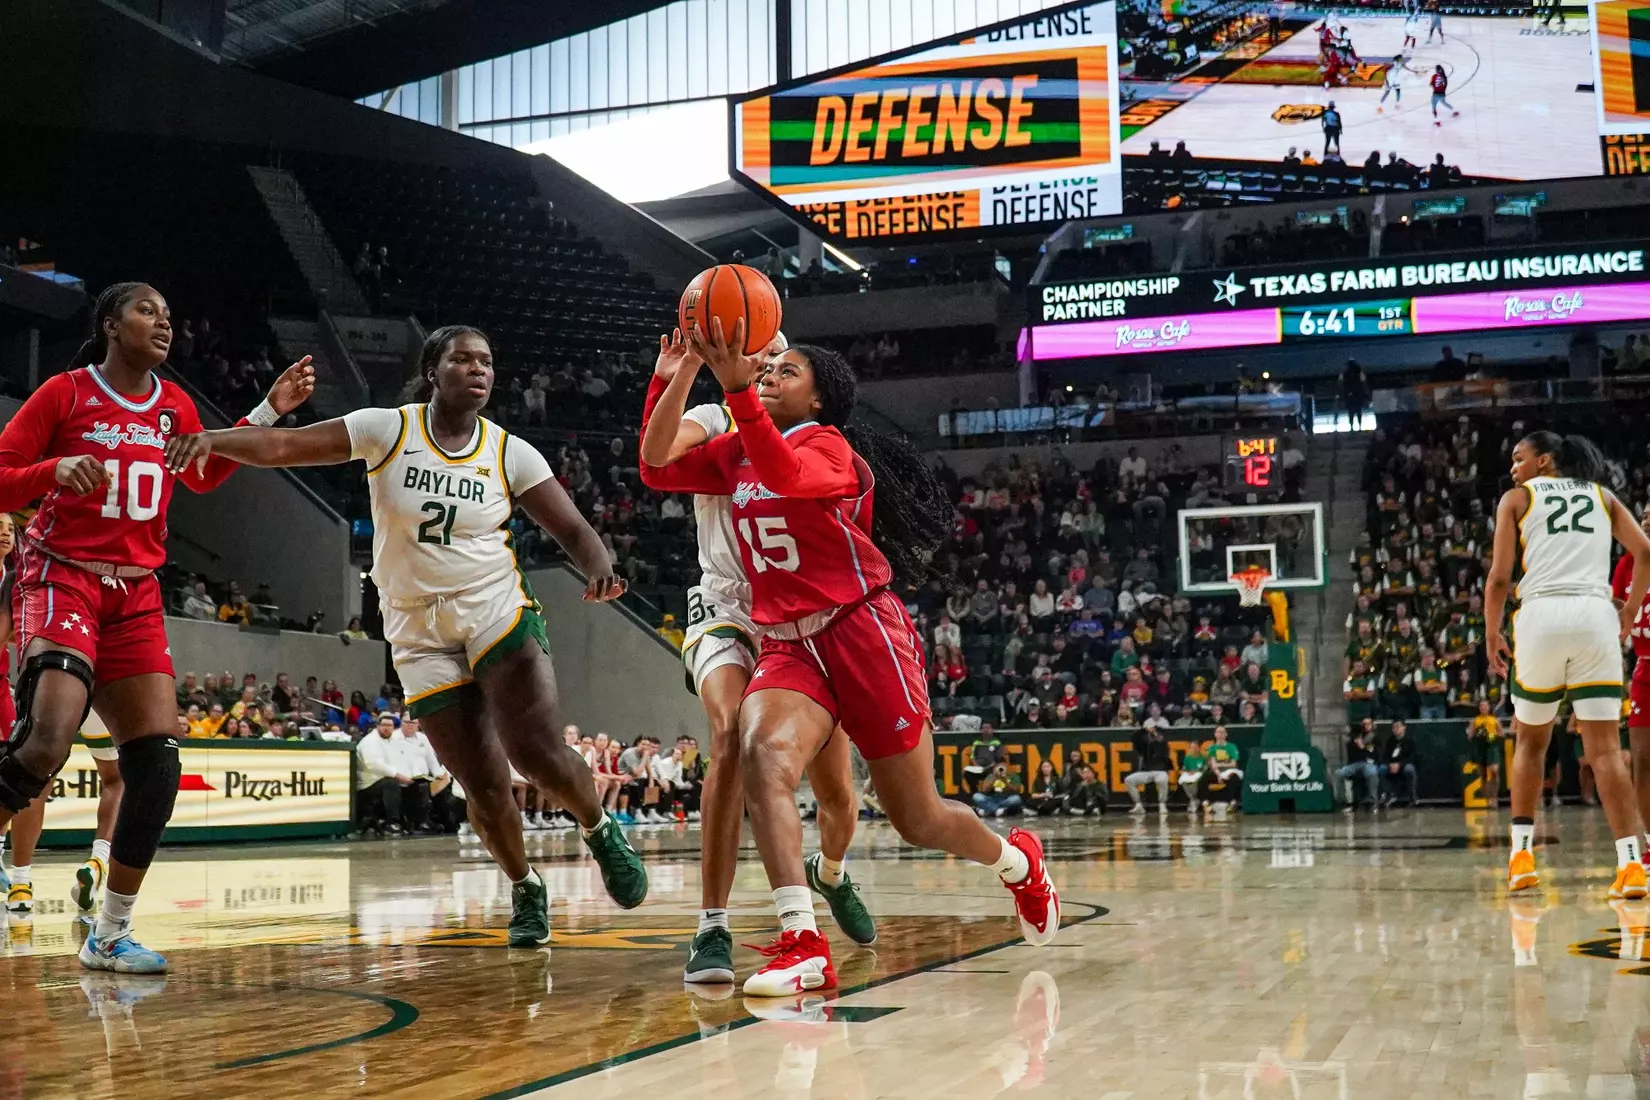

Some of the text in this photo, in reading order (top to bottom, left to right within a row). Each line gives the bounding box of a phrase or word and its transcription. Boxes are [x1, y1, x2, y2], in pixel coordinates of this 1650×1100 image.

[810, 74, 1039, 166] DEFENSE
[1042, 276, 1180, 303] CHAMPIONSHIP
[1250, 250, 1644, 298] TEXAS FARM BUREAU INSURANCE
[1043, 299, 1126, 321] PARTNER
[1299, 308, 1355, 335] 6:41
[1378, 306, 1402, 319] 1ST
[82, 421, 126, 450] Lady
[403, 466, 485, 503] BAYLOR
[1245, 455, 1271, 486] 12
[101, 459, 163, 521] 10
[417, 501, 457, 546] 21
[1544, 494, 1594, 535] 22
[738, 516, 800, 573] 15
[225, 771, 282, 801] Pizza
[1250, 781, 1324, 793] Your Bank for Life
